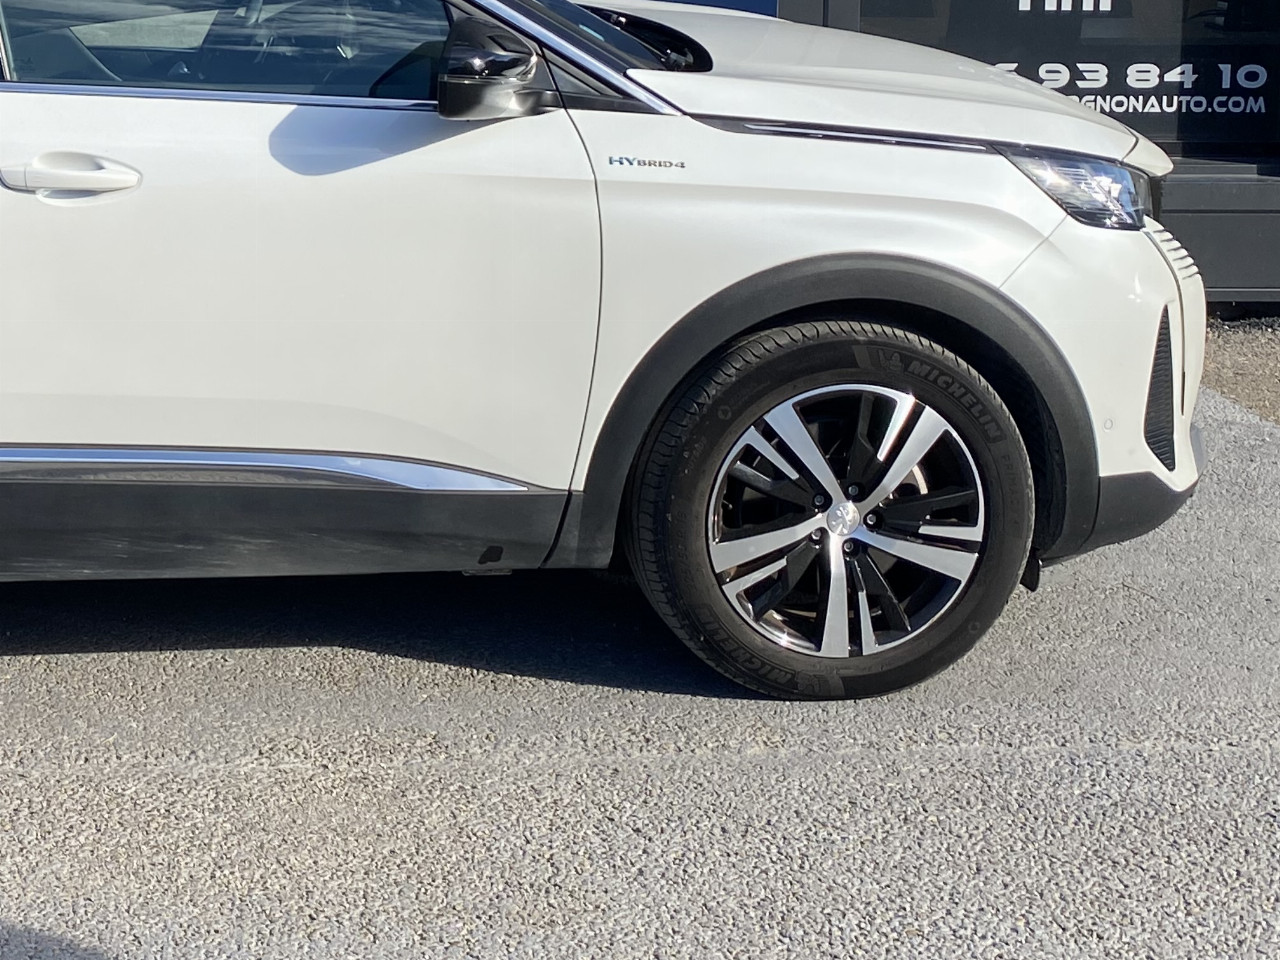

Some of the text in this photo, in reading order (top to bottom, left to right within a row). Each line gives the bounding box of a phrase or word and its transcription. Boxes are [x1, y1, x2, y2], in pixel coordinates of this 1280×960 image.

[1038, 62, 1109, 89] 93
[1126, 62, 1199, 89] 84
[1217, 63, 1268, 89] 10
[1067, 95, 1266, 114] GNONAUTO.COM
[907, 360, 1001, 440] MICHELIN
